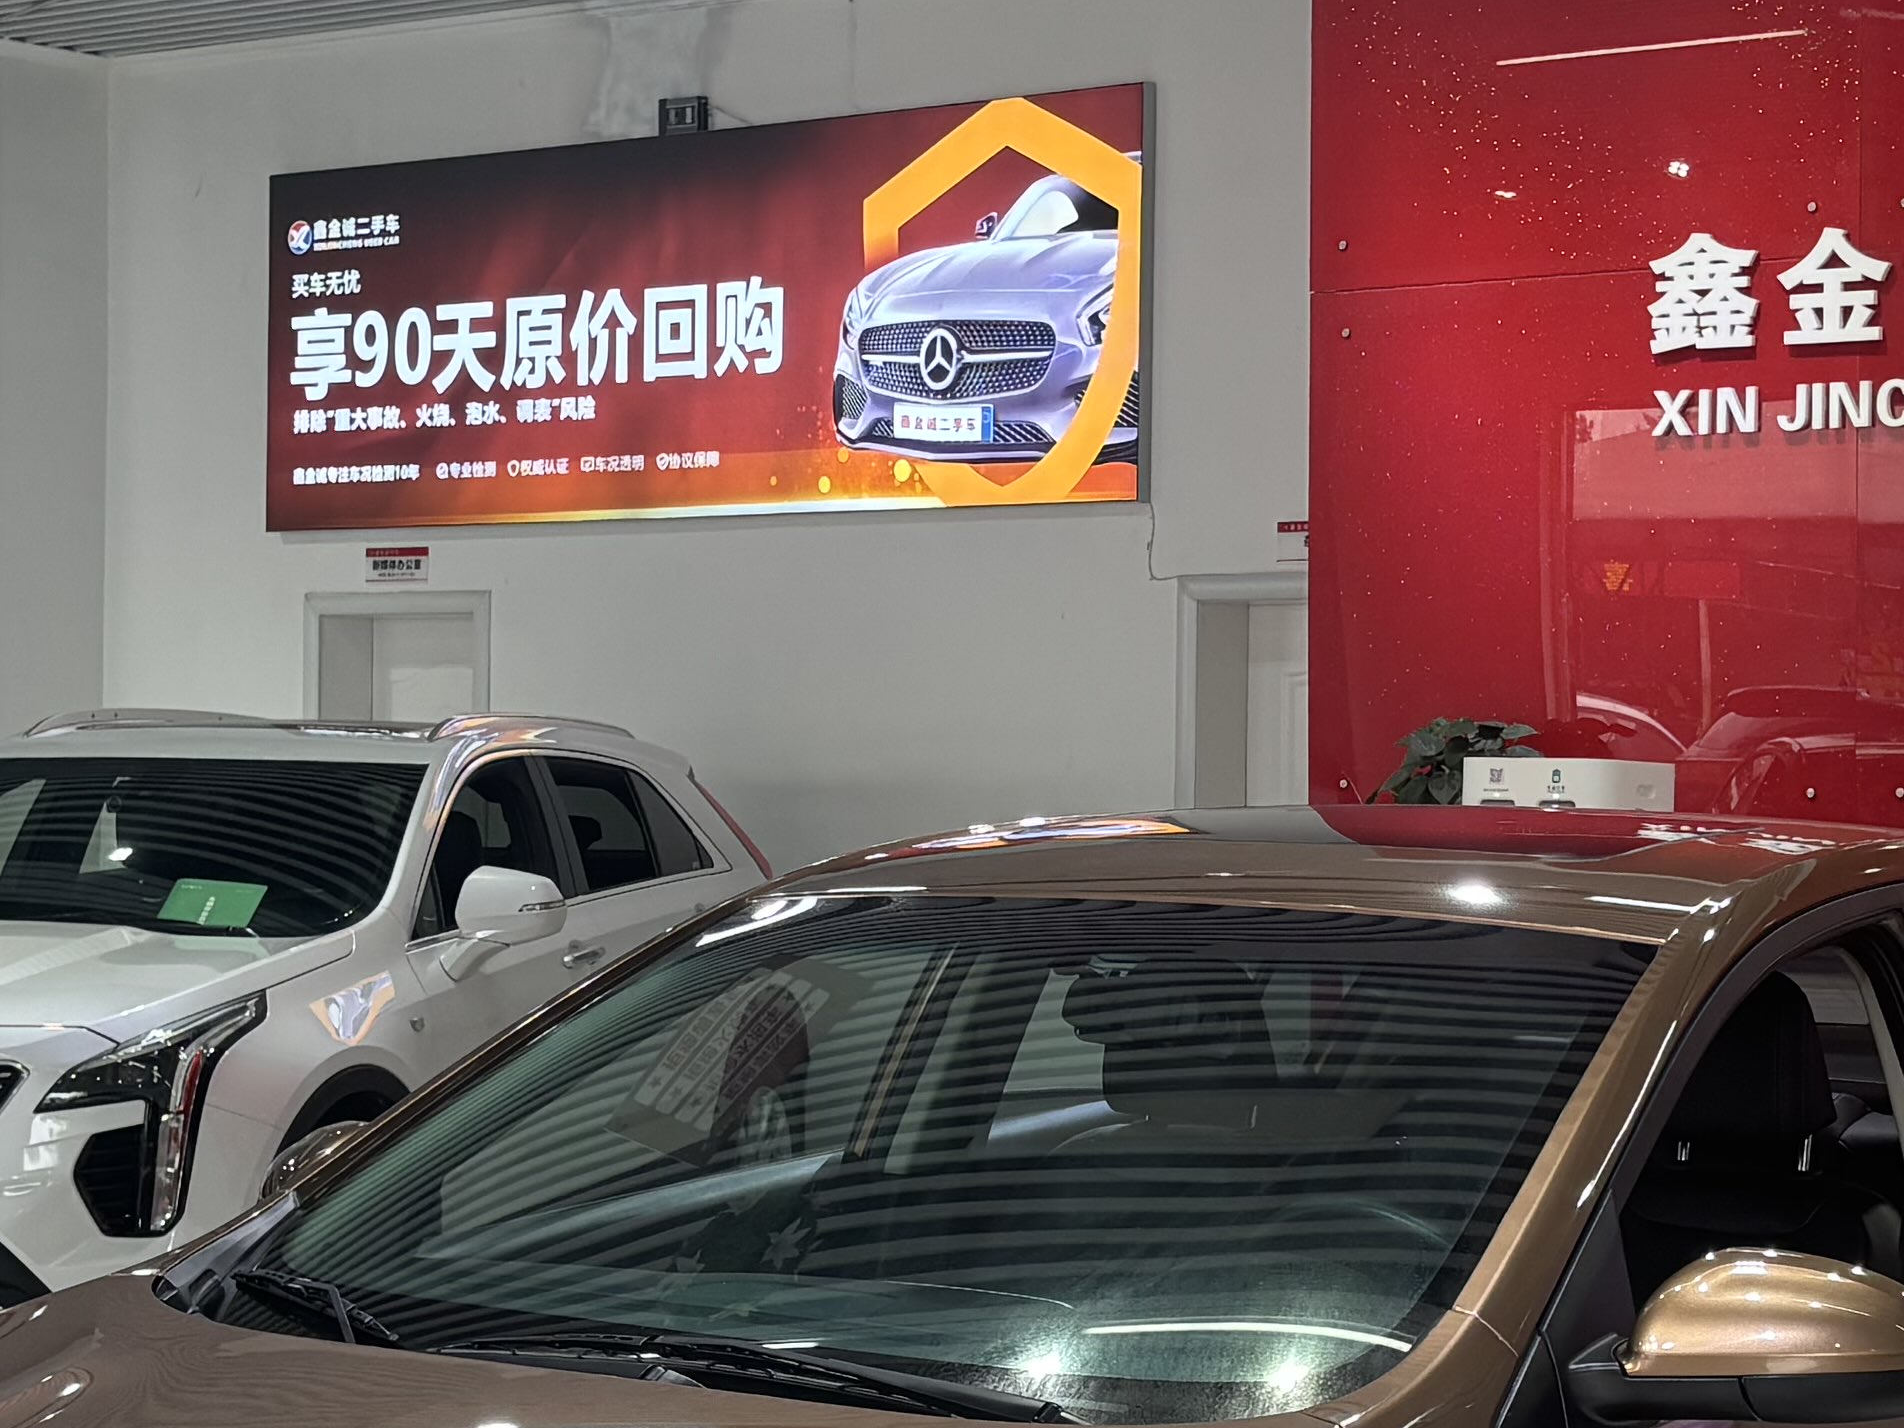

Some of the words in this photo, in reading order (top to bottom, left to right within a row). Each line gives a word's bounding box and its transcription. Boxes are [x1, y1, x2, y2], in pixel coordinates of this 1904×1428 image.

[291, 269, 361, 298] 买车无忧
[289, 276, 784, 401] 享90天原价回购
[1651, 386, 1759, 439] XIN
[595, 455, 645, 472] 车况透明
